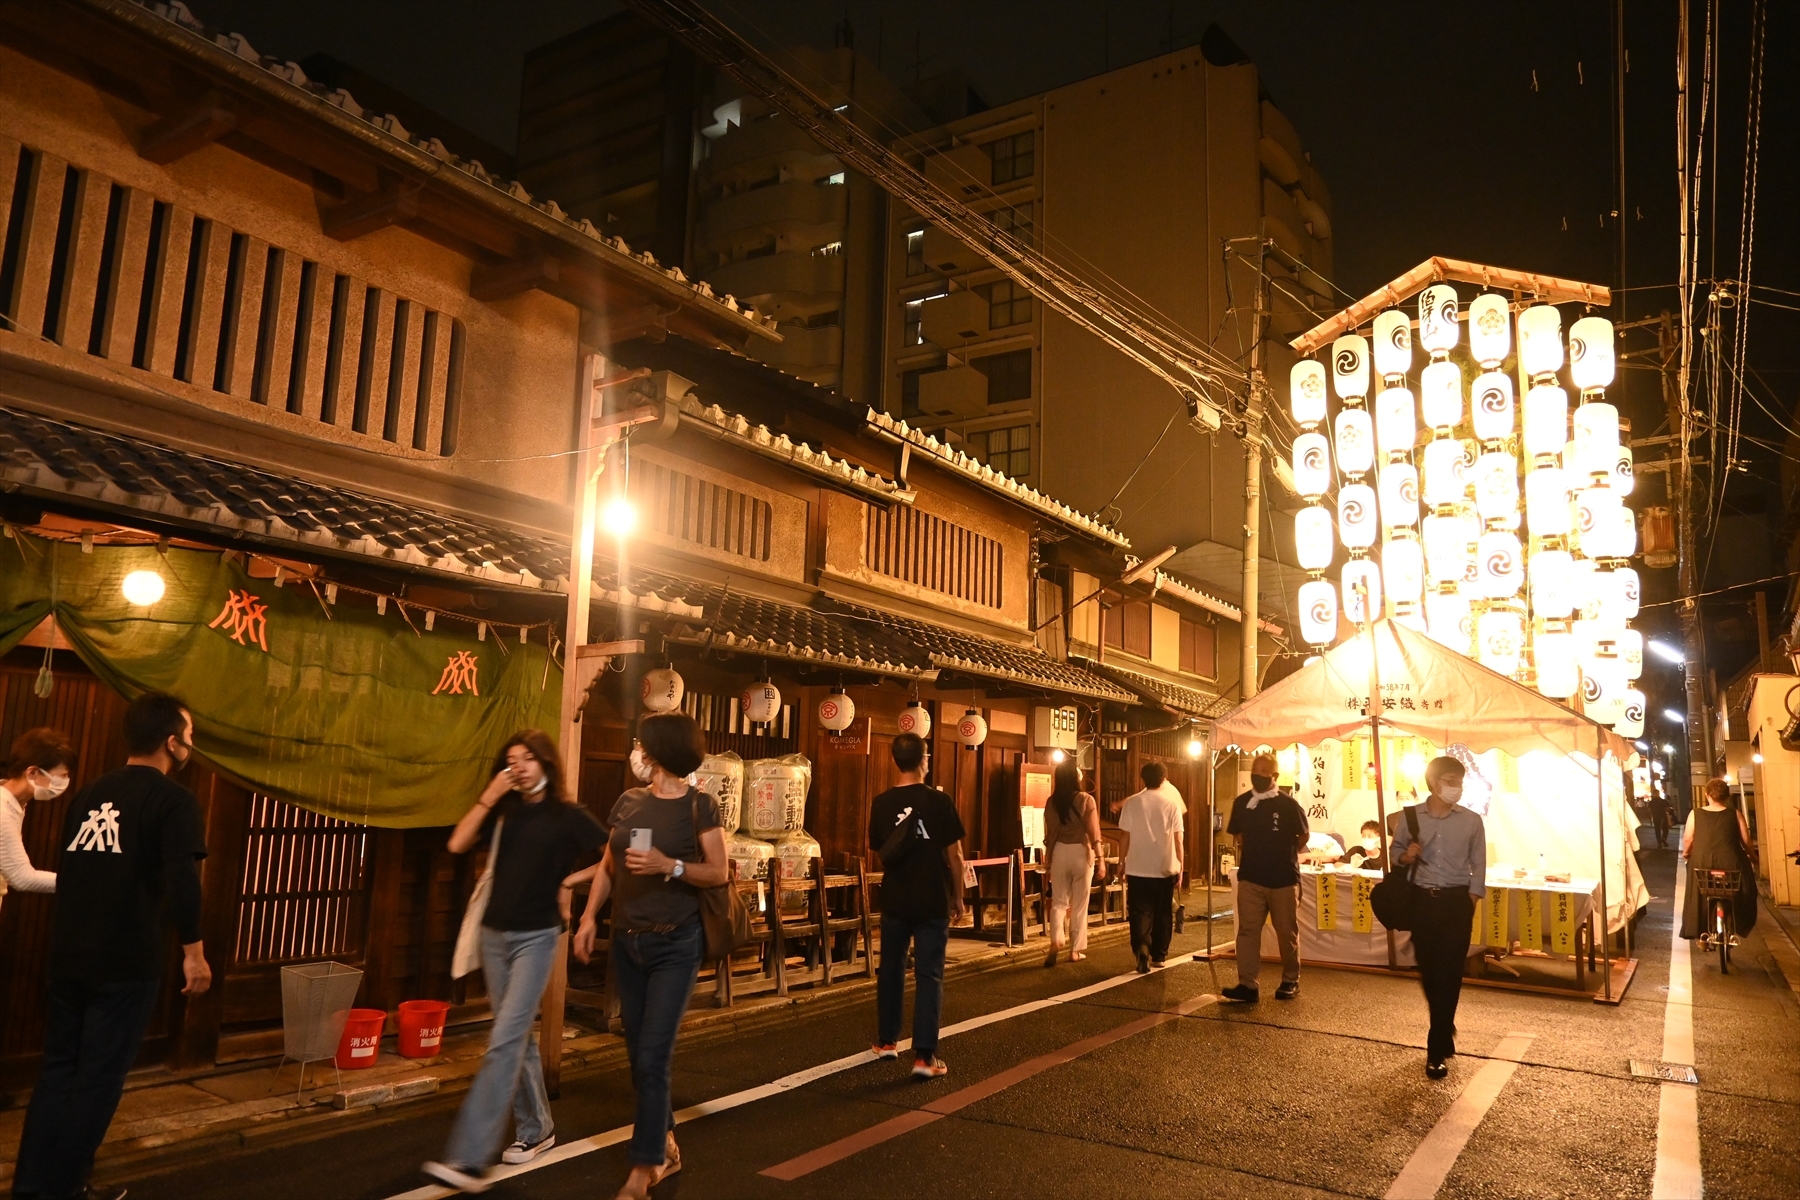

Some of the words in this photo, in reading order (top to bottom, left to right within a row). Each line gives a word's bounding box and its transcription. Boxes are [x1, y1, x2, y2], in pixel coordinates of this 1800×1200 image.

[1313, 757, 1325, 799] 伯牙山
[1322, 877, 1330, 898] タオル
[1559, 894, 1567, 922] 月刊京都
[350, 1036, 377, 1047] 消火用
